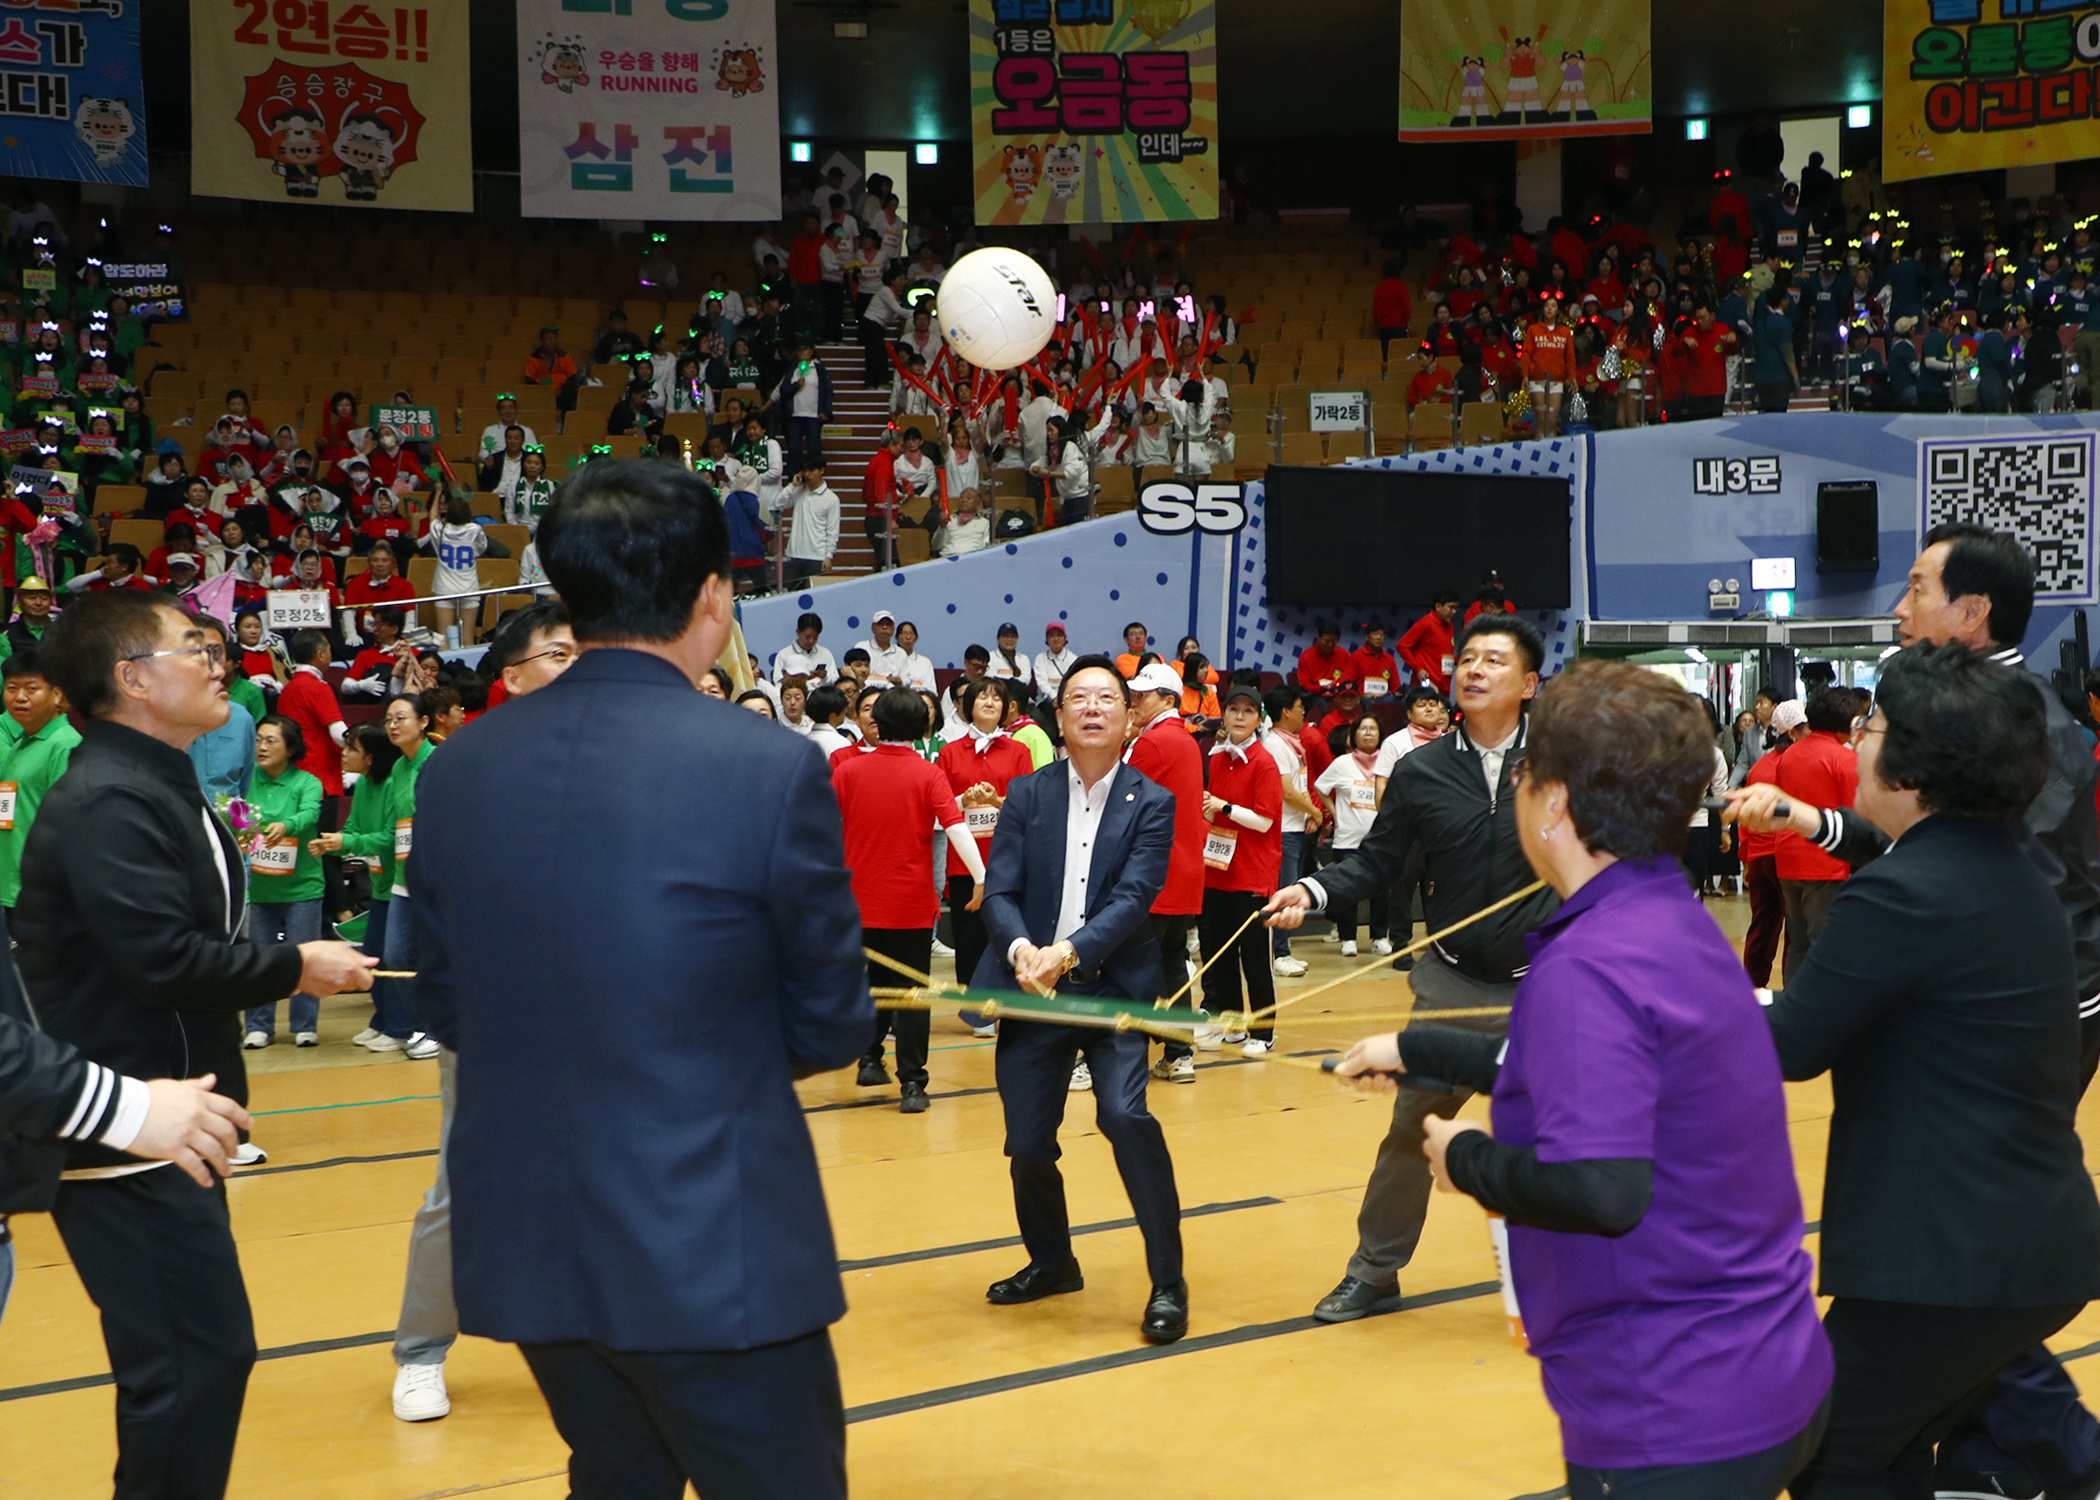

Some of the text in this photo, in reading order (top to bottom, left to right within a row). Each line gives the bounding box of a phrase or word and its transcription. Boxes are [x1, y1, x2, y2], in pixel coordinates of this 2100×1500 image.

[233, 0, 429, 63] 2연승!!
[996, 28, 1053, 53] 1등은
[599, 50, 699, 73] 우승을 향해
[600, 75, 699, 94] RUNNING
[993, 53, 1190, 129] 오금동
[379, 408, 431, 425] 문정2동
[1314, 404, 1361, 421] 가락2동
[1695, 457, 1780, 494] 내3문
[1140, 482, 1246, 532] S5
[273, 609, 325, 622] 문정2동
[969, 811, 1000, 825] 문정2
